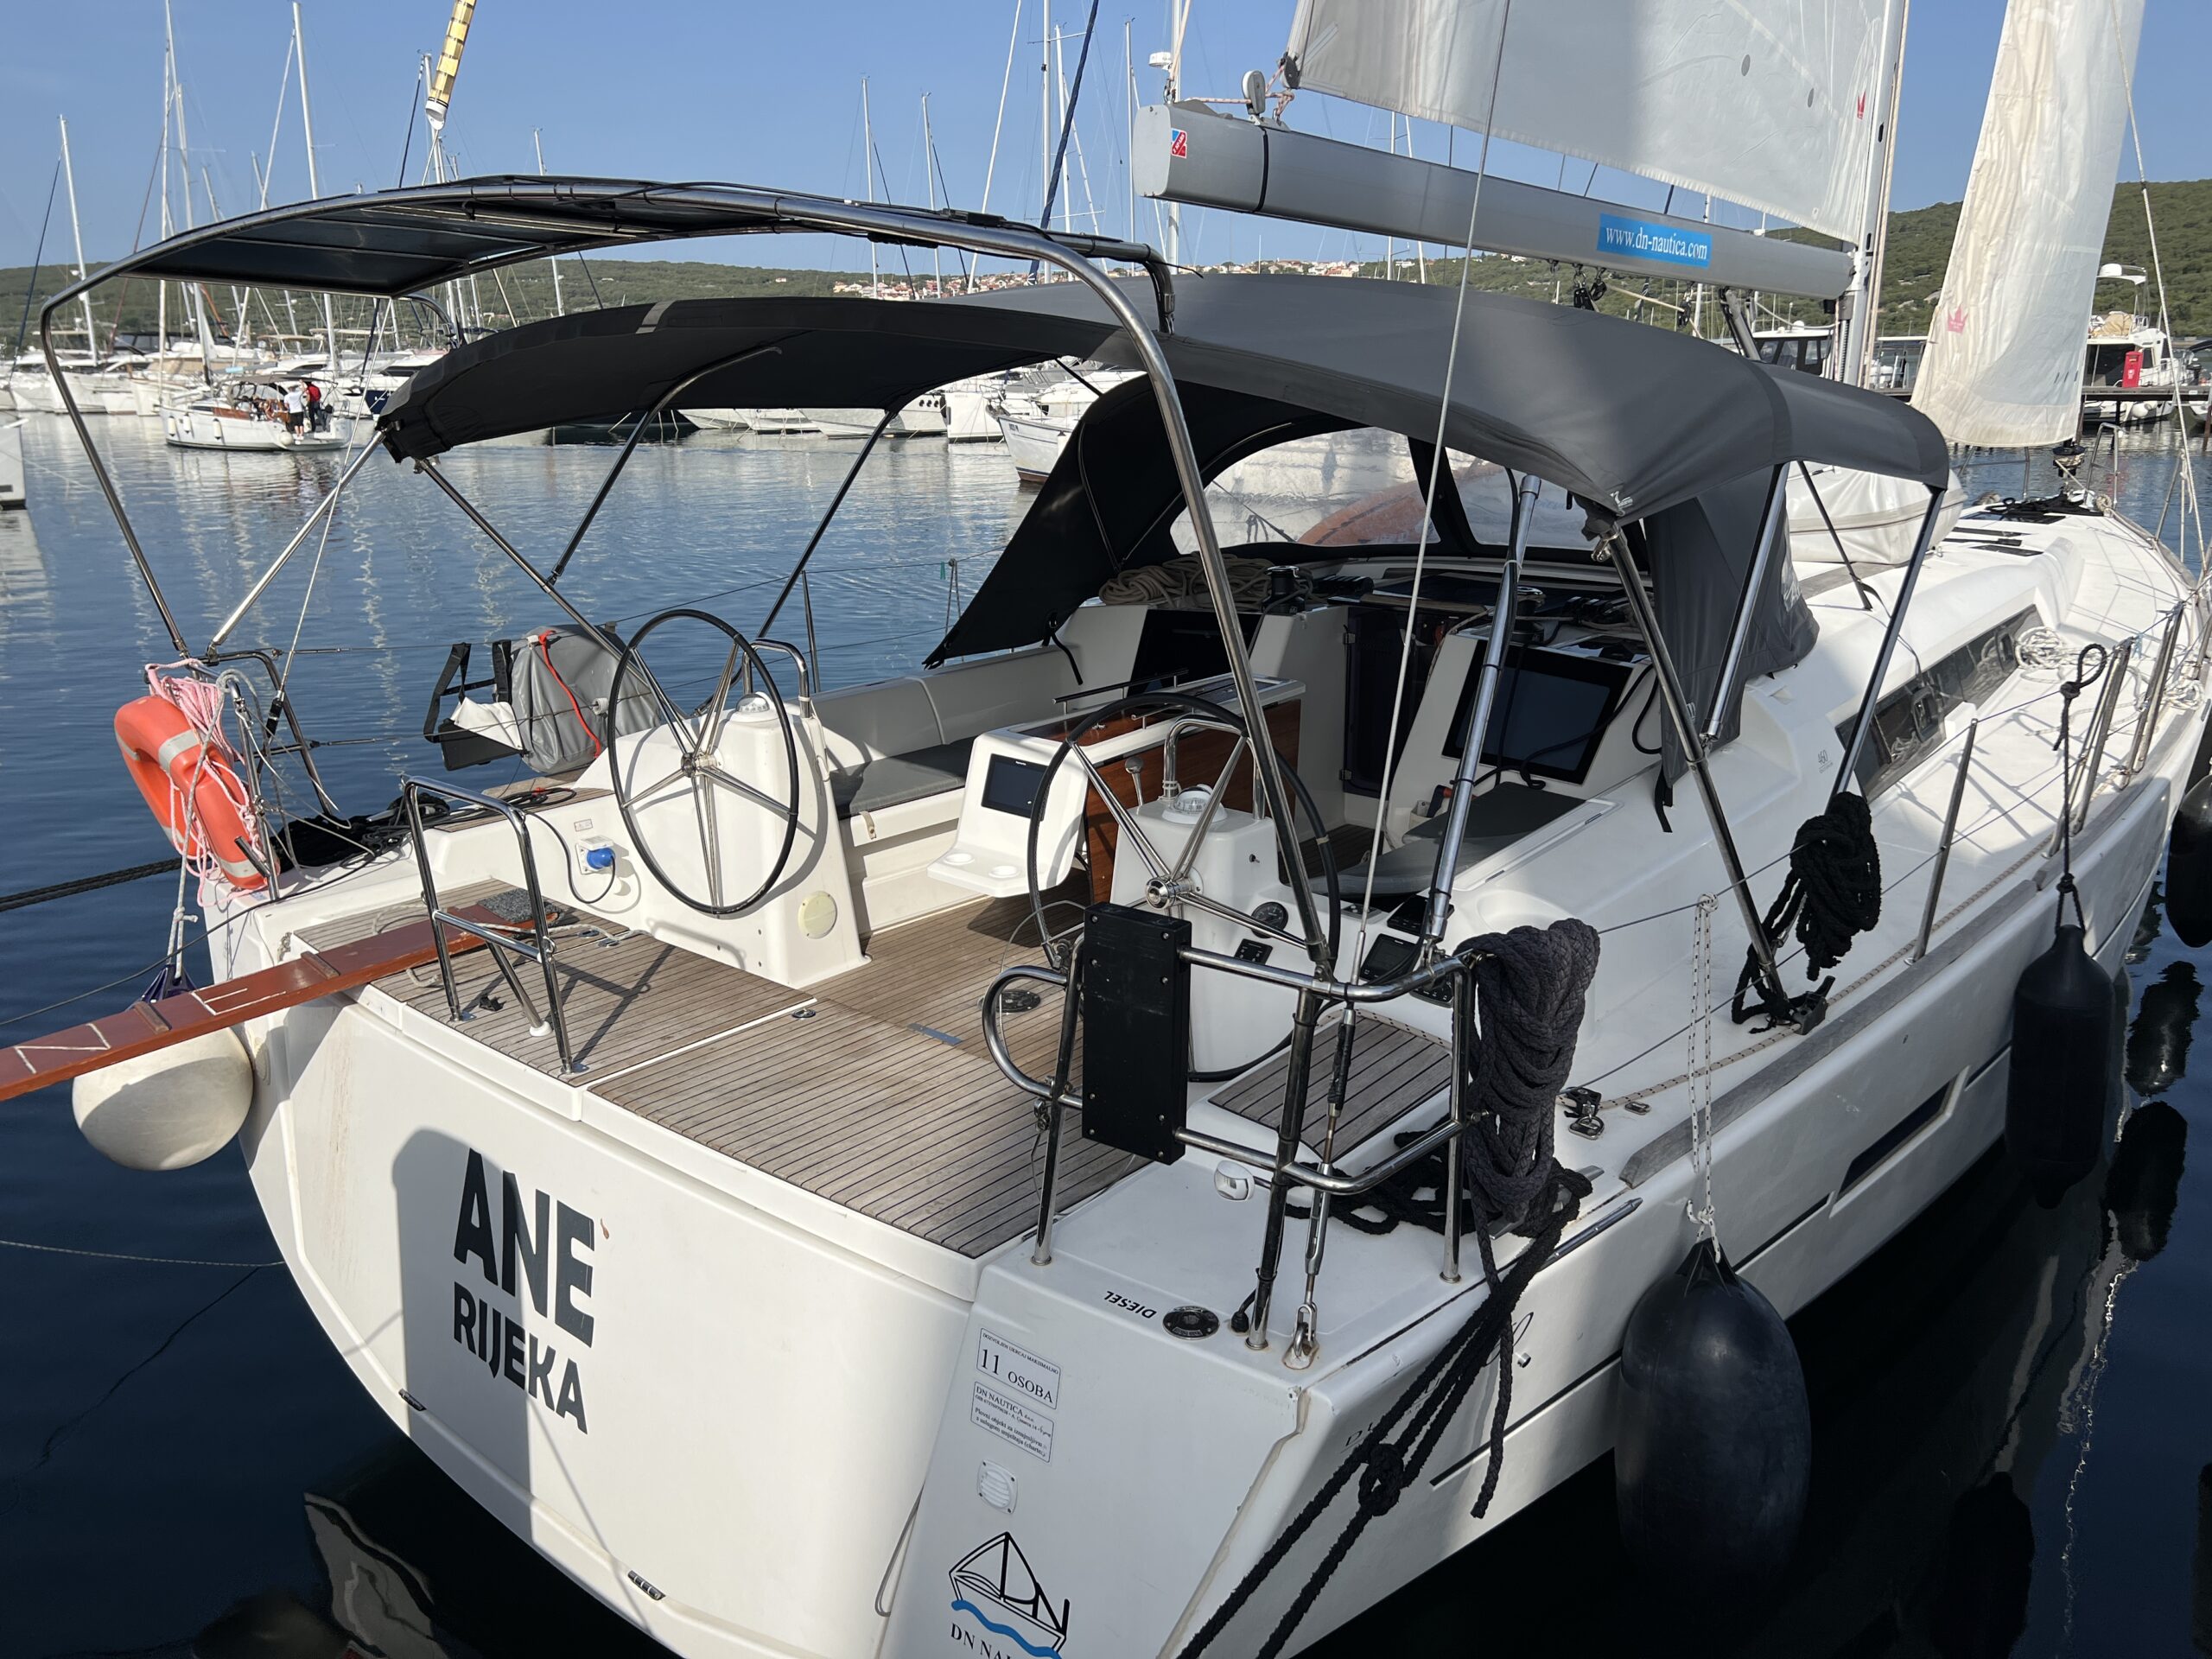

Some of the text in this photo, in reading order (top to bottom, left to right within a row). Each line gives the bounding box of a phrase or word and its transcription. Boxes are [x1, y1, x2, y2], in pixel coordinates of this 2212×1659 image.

[1605, 226, 1708, 260] www.dn-nautica.com
[454, 1147, 594, 1348] ANE
[1103, 1290, 1158, 1319] DIESEL
[454, 1281, 588, 1435] RIJEKA
[982, 1349, 1053, 1403] 11 OSOBA
[976, 1386, 988, 1397] DN
[988, 1392, 1023, 1417] NAUTICA
[951, 1623, 1011, 1659] DN NA
